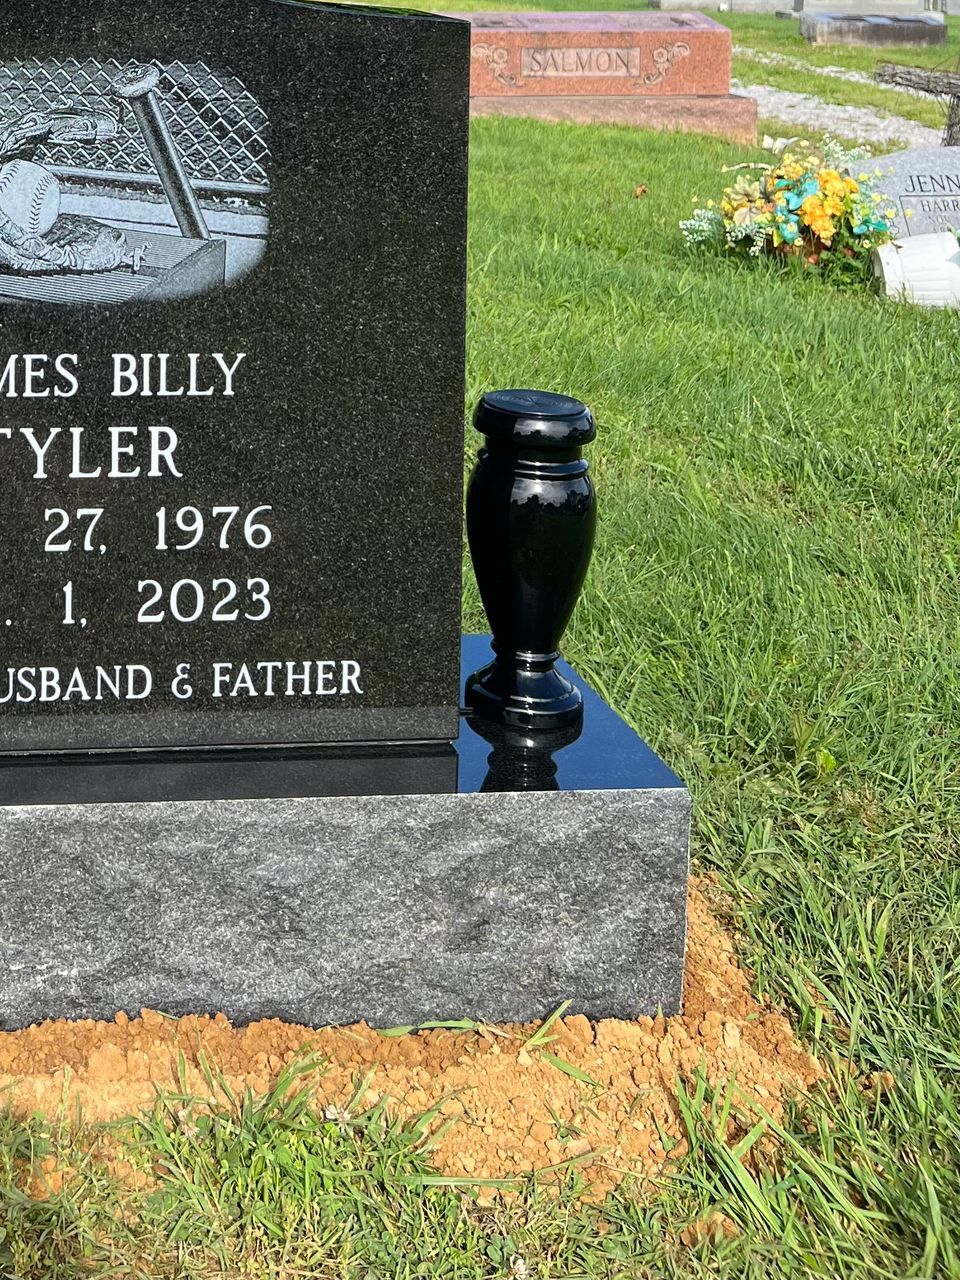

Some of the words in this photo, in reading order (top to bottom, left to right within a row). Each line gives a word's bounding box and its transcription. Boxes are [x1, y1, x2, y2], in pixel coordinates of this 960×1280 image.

[529, 51, 631, 73] SALMON
[110, 352, 247, 397] BILLY
[44, 507, 107, 555] 27,
[155, 504, 273, 550] 1976
[62, 580, 87, 629] 1,
[137, 577, 271, 623] 2023
[171, 662, 193, 699] &
[212, 660, 364, 698] FATHER
